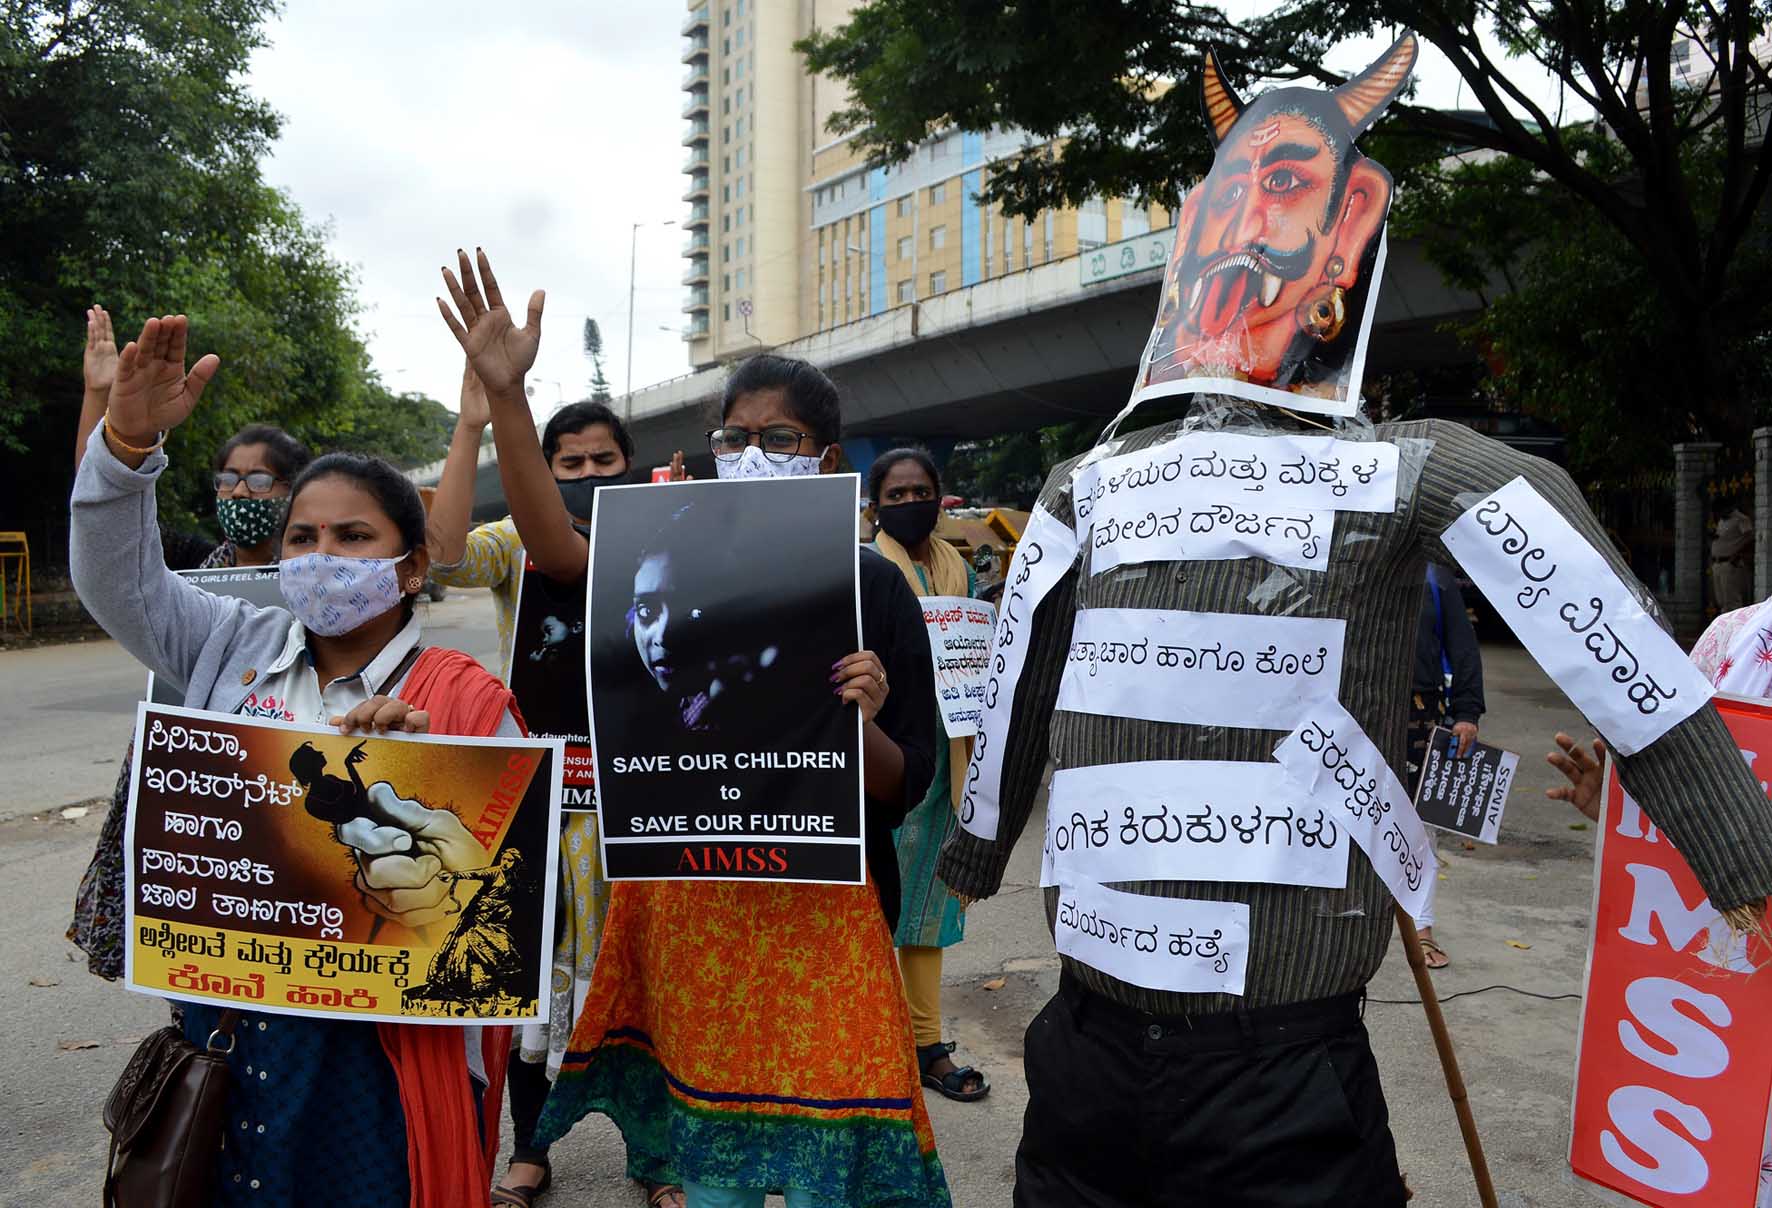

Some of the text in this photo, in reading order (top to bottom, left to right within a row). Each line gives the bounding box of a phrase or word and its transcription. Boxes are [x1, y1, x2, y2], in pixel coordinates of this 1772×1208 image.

[1190, 450, 1268, 492] ಮತ್ತು
[1278, 455, 1379, 497] ಮಕ್ಕಳ
[1094, 504, 1321, 560] ಮೇಲಿನ ದೌರ್ಜನ್ಯ
[201, 574, 228, 583] GIRLS
[230, 573, 252, 582] FEEL
[254, 571, 280, 581] SAFE
[1475, 499, 1677, 715] ಬಾಲ್ಯ ವಿವಾಹ
[1156, 642, 1245, 672] ಹಾಗೂ
[1256, 645, 1327, 675] ಕೊಲೆ
[148, 719, 248, 761] ಸಿನಿಮಾ,
[612, 751, 846, 774] SAVE OUR CHILDREN
[576, 769, 595, 778] AN
[719, 784, 742, 801] to
[1487, 766, 1511, 826] AIMSS
[472, 753, 532, 850] AIMSS
[630, 814, 835, 833] SAVE OUR FUTURE
[1300, 720, 1424, 892] ವರದಕ್ಷಿಣೆ ಸಾವು
[164, 810, 243, 841] ಹಾಗೂ
[1045, 804, 1337, 862] ಂಗಿಕ ಕಿರುಕುಳಗಳು
[142, 847, 275, 885] ಸಾಮಾಜಿಕ
[676, 847, 788, 873] AIMSS
[140, 882, 344, 940] ಜಾಲ ತಾಣಗಳಲ್ಲಿ
[140, 922, 410, 988] ಅಶ್ಲೀಲತೆ ಮತ್ತು ಕ್ರೌರ್ಯಕ್ಕೆ
[1060, 900, 1231, 974] ಮರ್ಯಾದ ಹತ್ಯೆ
[167, 963, 379, 1010] ಕೊನೆ ಹಾಕಿ
